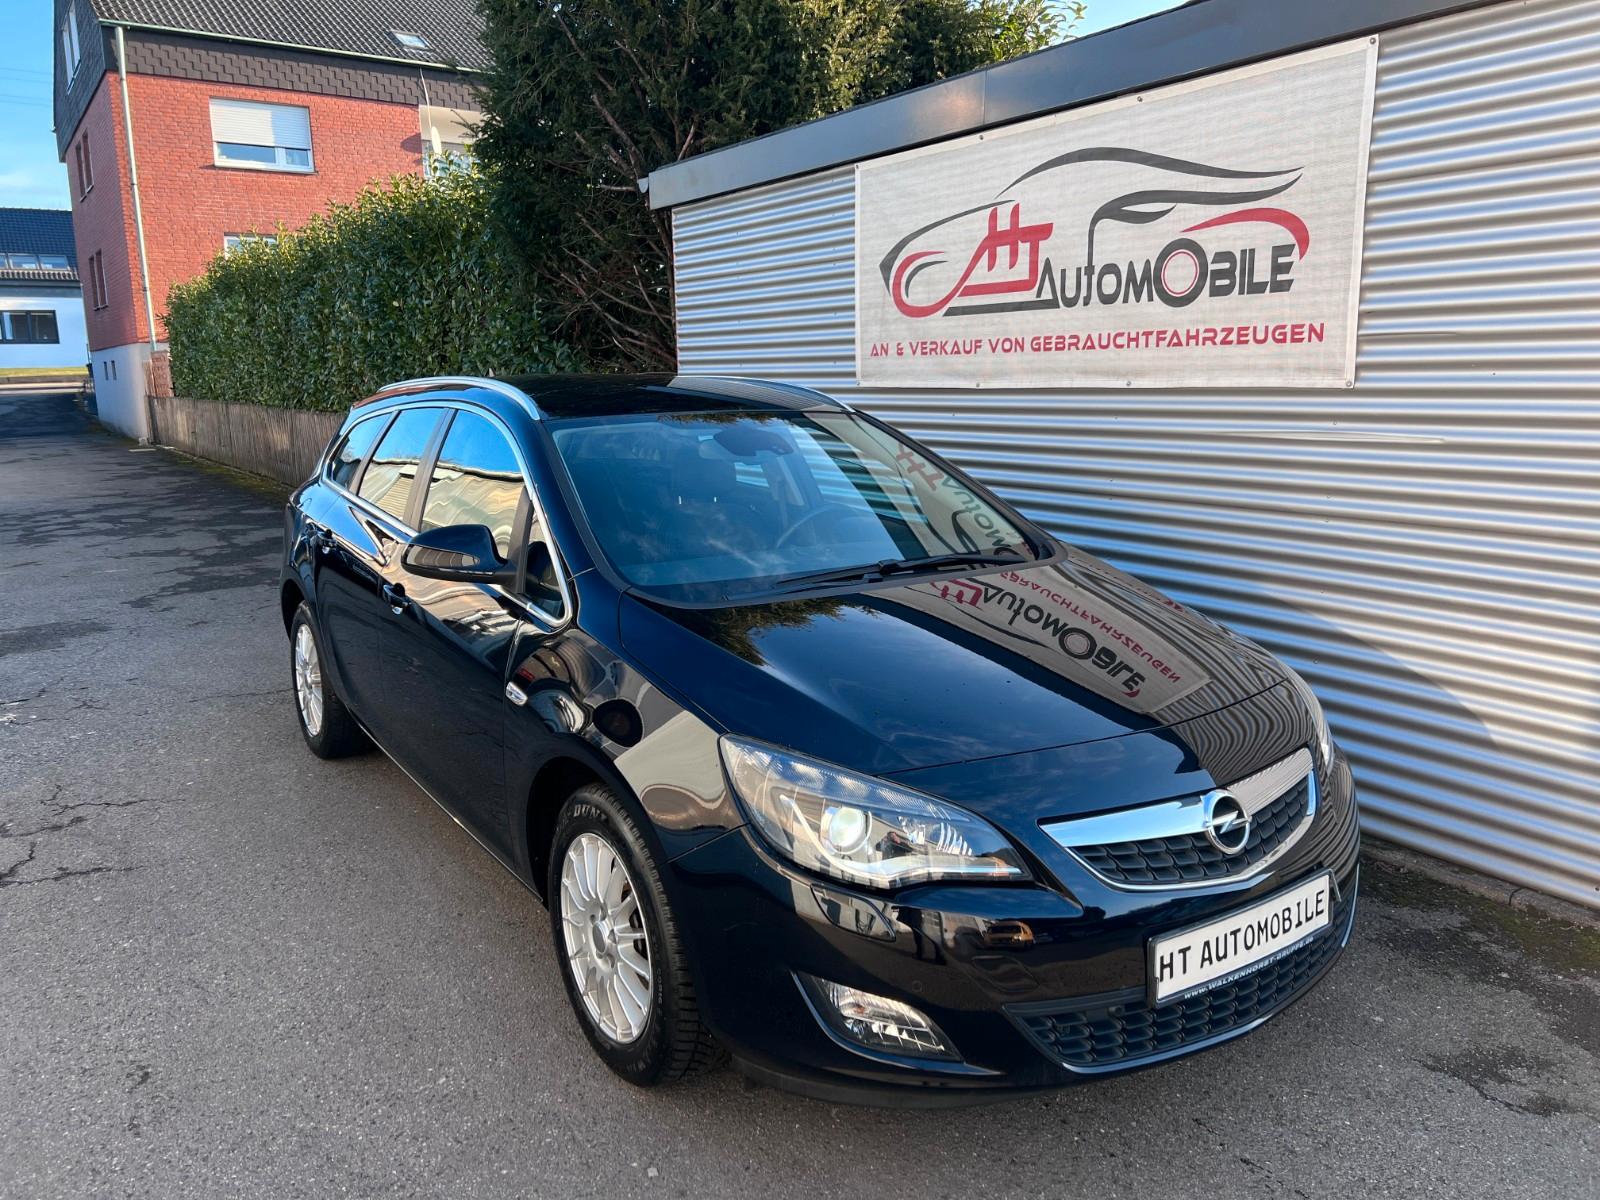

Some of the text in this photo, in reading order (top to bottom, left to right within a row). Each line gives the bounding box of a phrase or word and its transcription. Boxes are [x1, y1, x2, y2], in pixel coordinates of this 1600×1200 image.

[870, 322, 1326, 357] AN & VERKAUF VON GEBRAUCHTFAHRZEUGEN
[1159, 889, 1325, 982] HT AUTOMOBILE
